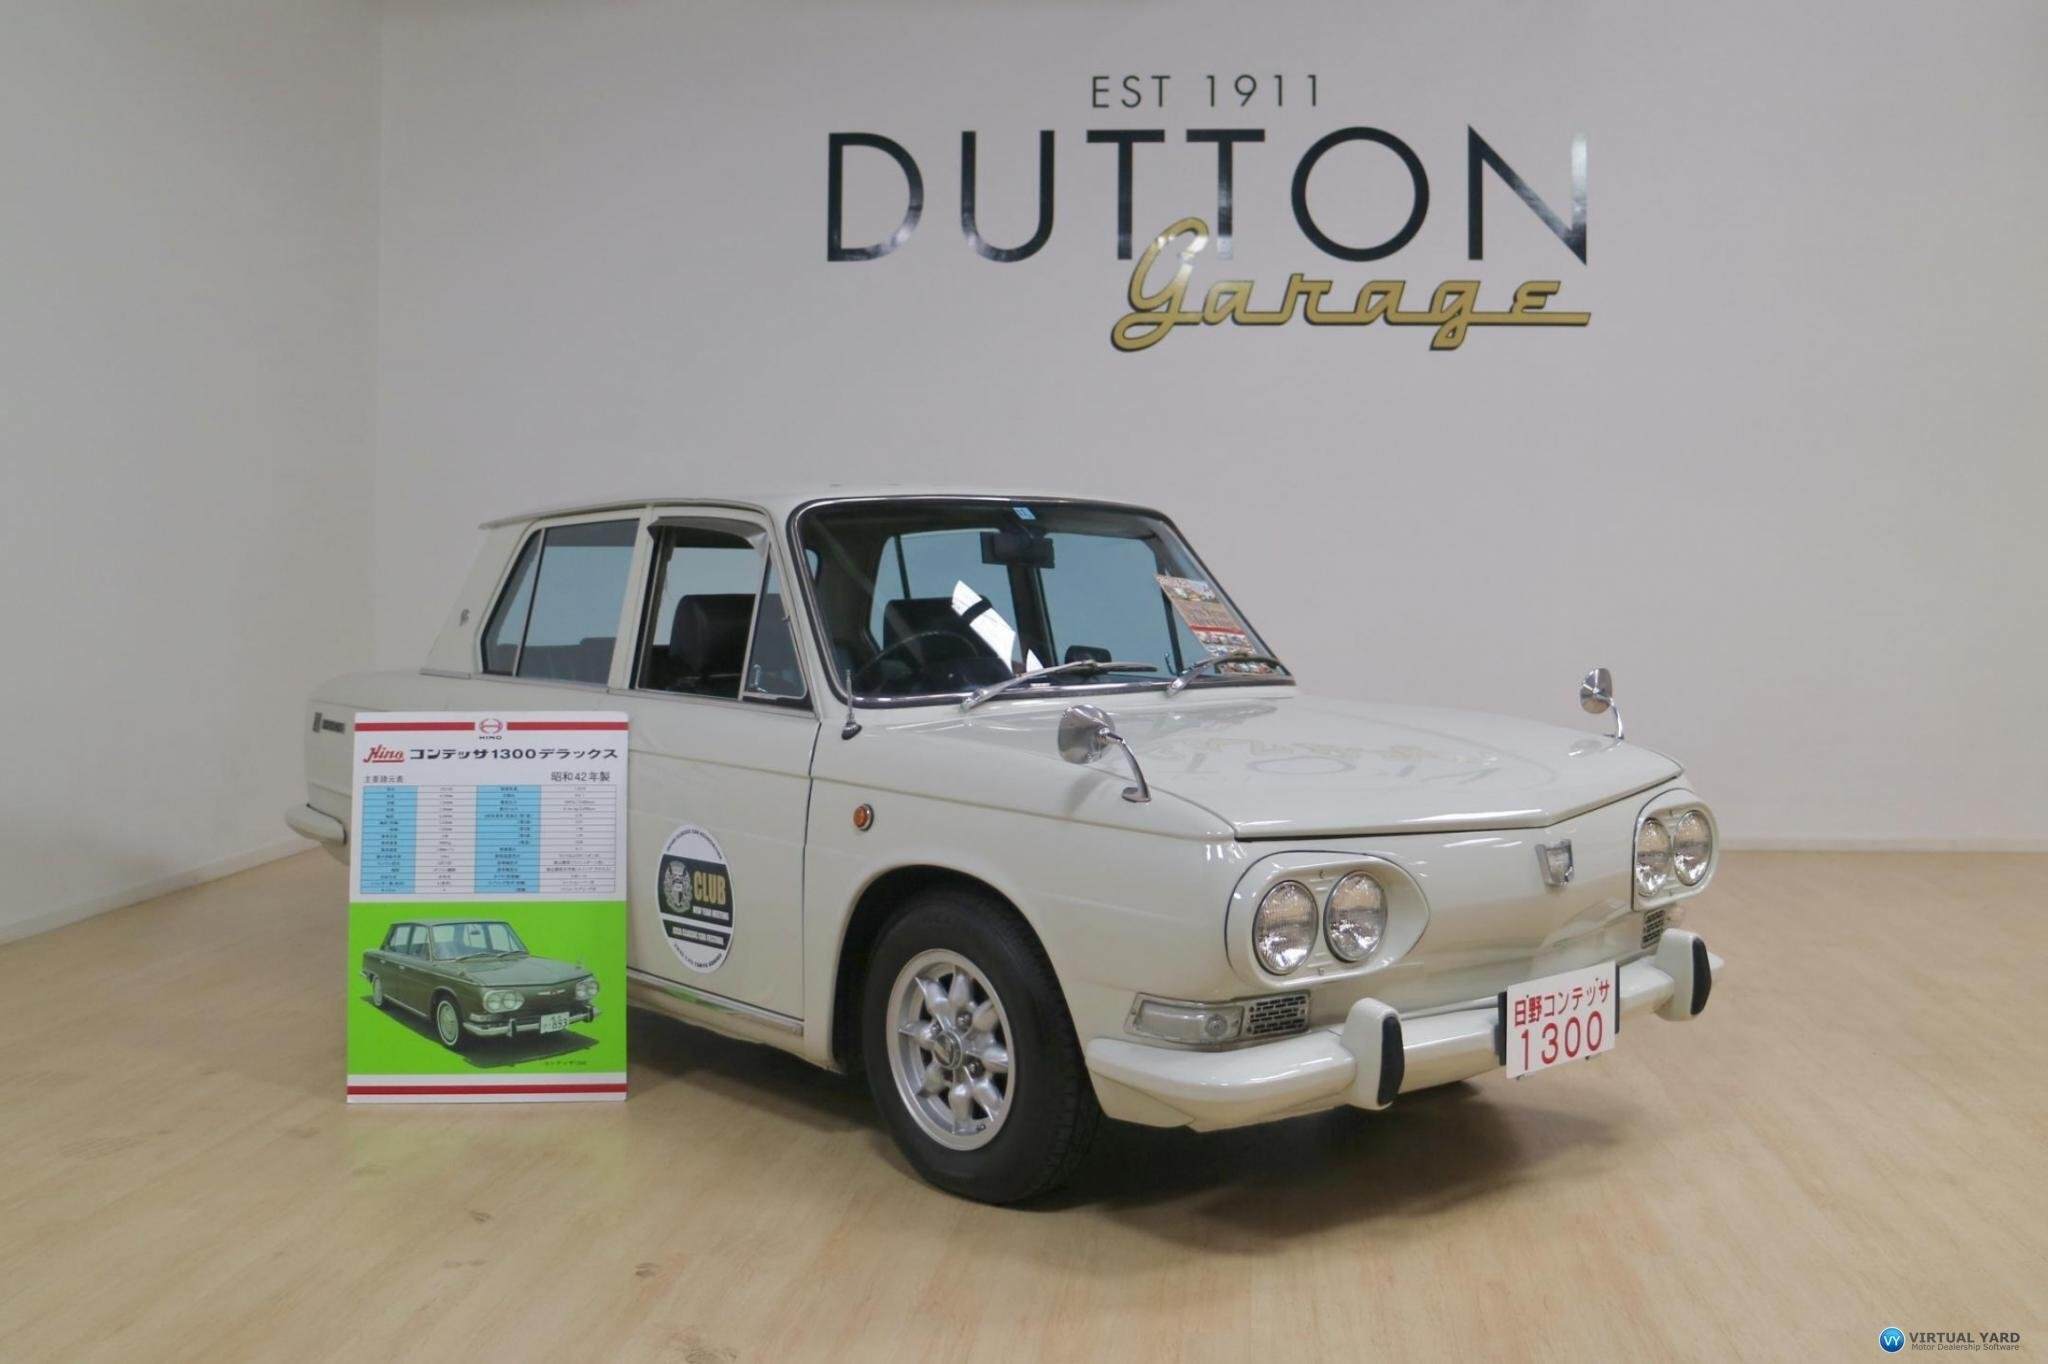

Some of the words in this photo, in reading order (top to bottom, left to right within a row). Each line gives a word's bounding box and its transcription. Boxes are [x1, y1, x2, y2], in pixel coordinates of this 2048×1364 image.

[1091, 75, 1171, 108] EST
[1206, 75, 1320, 108] 1911
[827, 124, 1587, 265] DUTTON
[1111, 217, 1591, 352] Garage
[362, 744, 405, 763] Hino
[410, 748, 618, 760] コンテッサ1300デラックス
[551, 771, 611, 782] 昭和42年製
[693, 870, 726, 905] CLUB
[1514, 979, 1610, 1027] 日野コンテッサ
[1521, 1010, 1603, 1071] 1300
